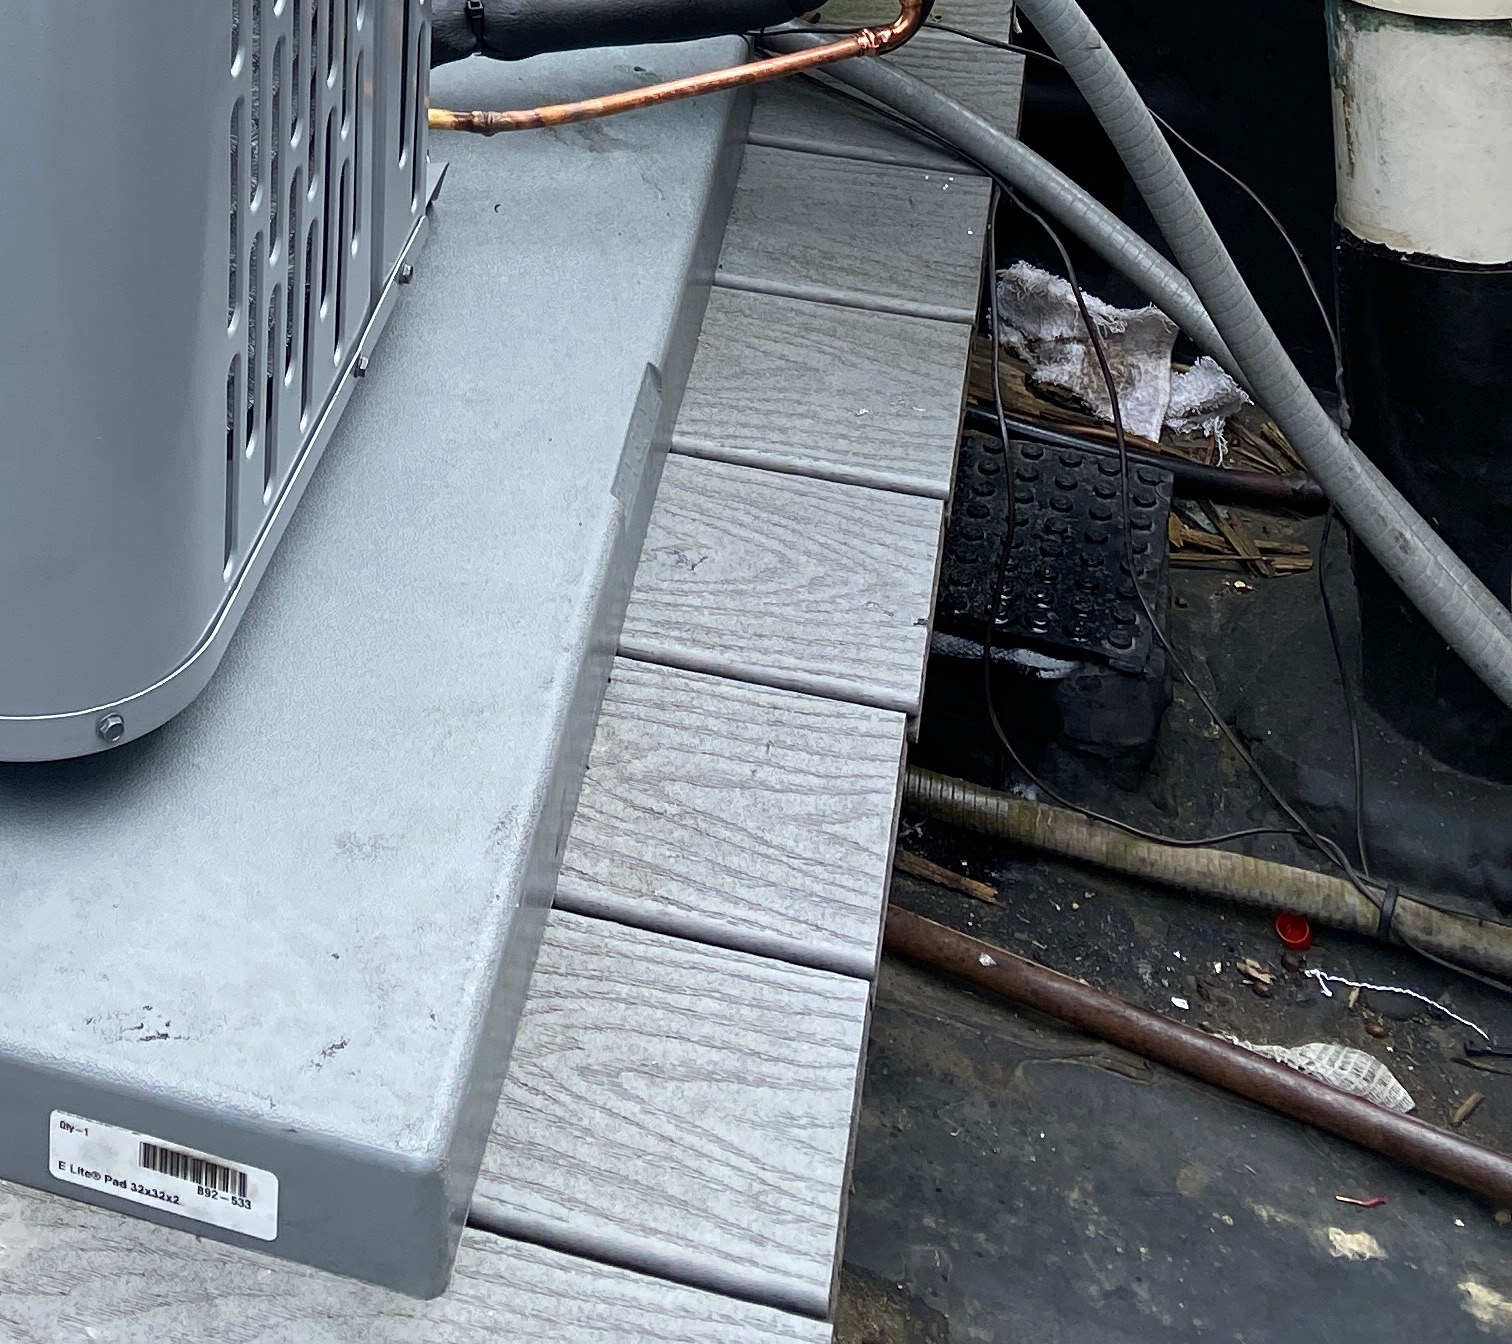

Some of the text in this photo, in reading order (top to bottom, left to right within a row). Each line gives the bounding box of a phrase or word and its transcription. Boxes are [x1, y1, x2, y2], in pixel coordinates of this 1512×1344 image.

[58, 1160, 66, 1171] E
[104, 1174, 128, 1189] Pad
[130, 1183, 181, 1206] 32x32x2
